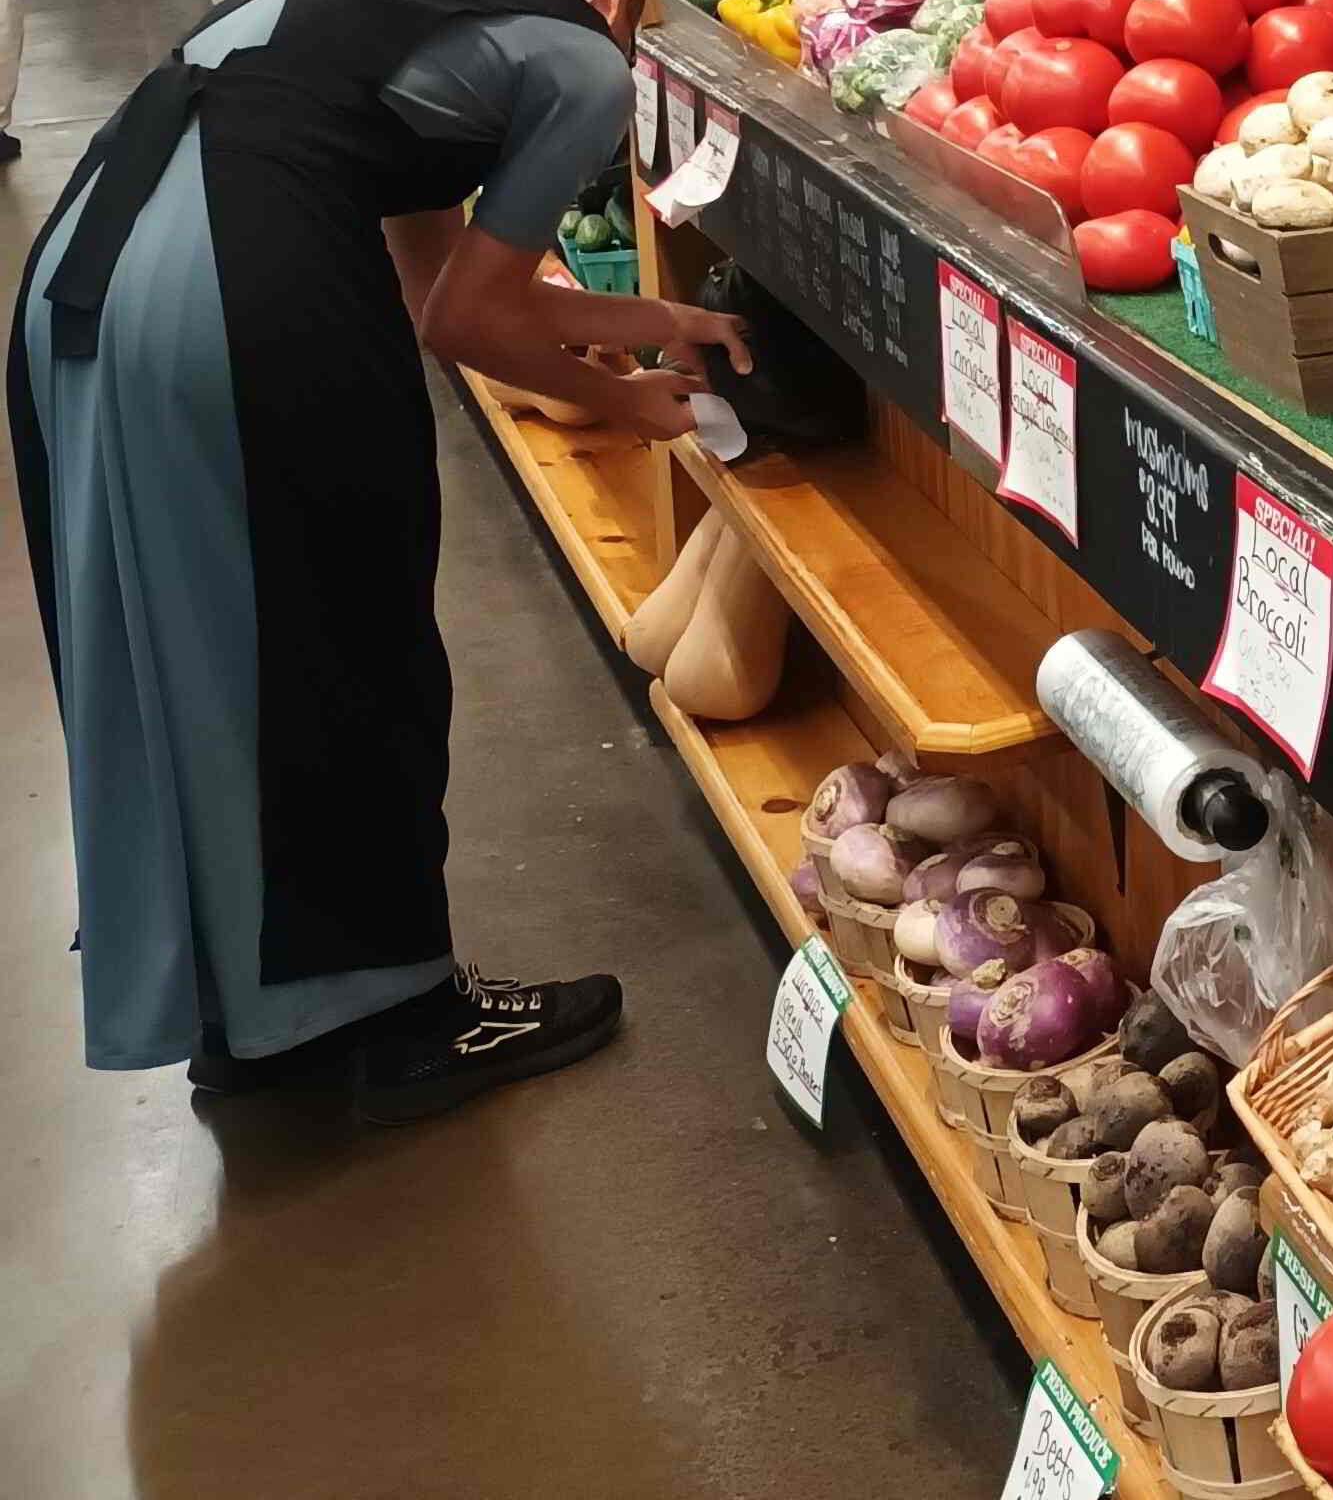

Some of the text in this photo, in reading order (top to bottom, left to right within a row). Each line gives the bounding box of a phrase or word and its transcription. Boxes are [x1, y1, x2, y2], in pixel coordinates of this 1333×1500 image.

[949, 273, 986, 313] SPECIAL!
[951, 297, 986, 350] Local
[1020, 332, 1062, 378] SPECIAL!
[1021, 355, 1058, 412] Local
[1254, 496, 1316, 561] SPECIAL!
[1252, 518, 1314, 608] Local
[1236, 555, 1309, 660] Broccoli
[1278, 1236, 1317, 1302] FRESH
[1041, 1361, 1114, 1470] FRESH PRODUCE
[1032, 1409, 1075, 1500] Beets
